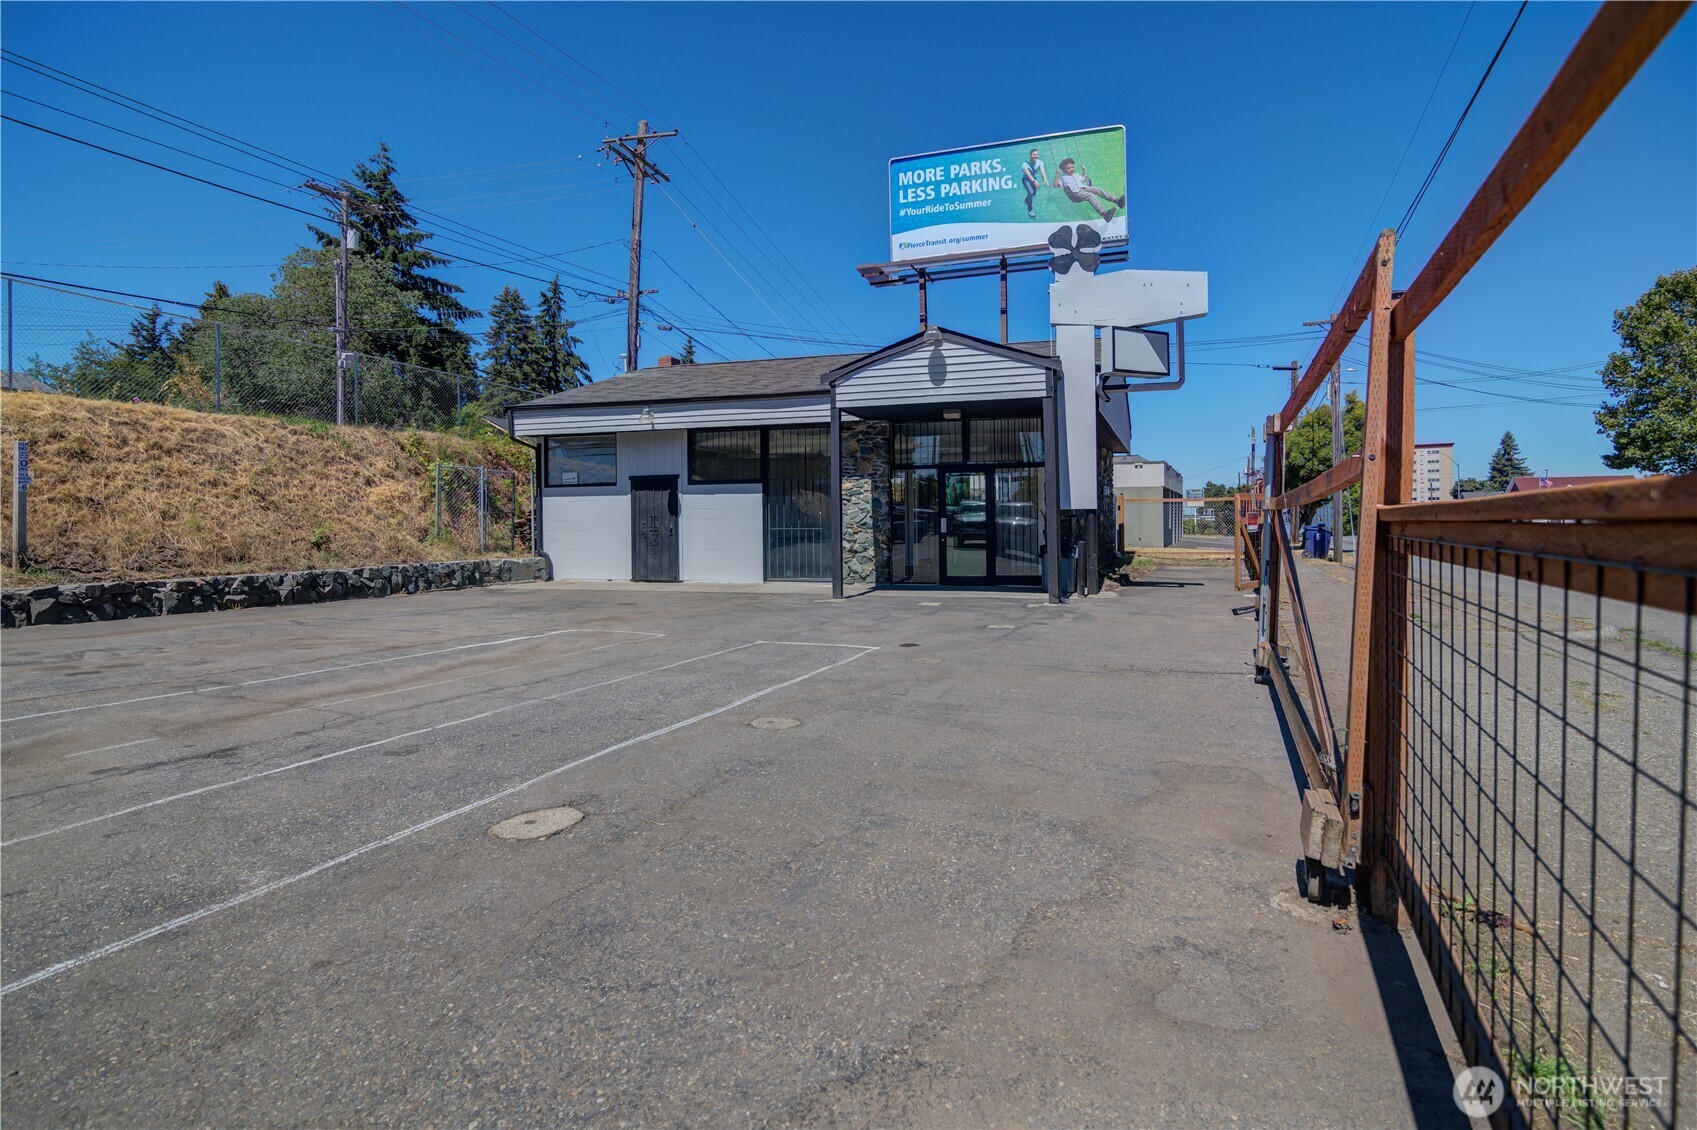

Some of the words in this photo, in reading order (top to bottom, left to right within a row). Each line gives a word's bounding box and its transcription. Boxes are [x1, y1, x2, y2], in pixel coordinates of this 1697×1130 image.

[899, 166, 945, 186] MORE
[950, 158, 1006, 179] PARKS.
[899, 185, 936, 204] LESS
[940, 174, 1018, 198] PARKING.
[899, 199, 992, 217] #YourRideToSummer
[907, 234, 989, 249] PierceTransit.org/summer
